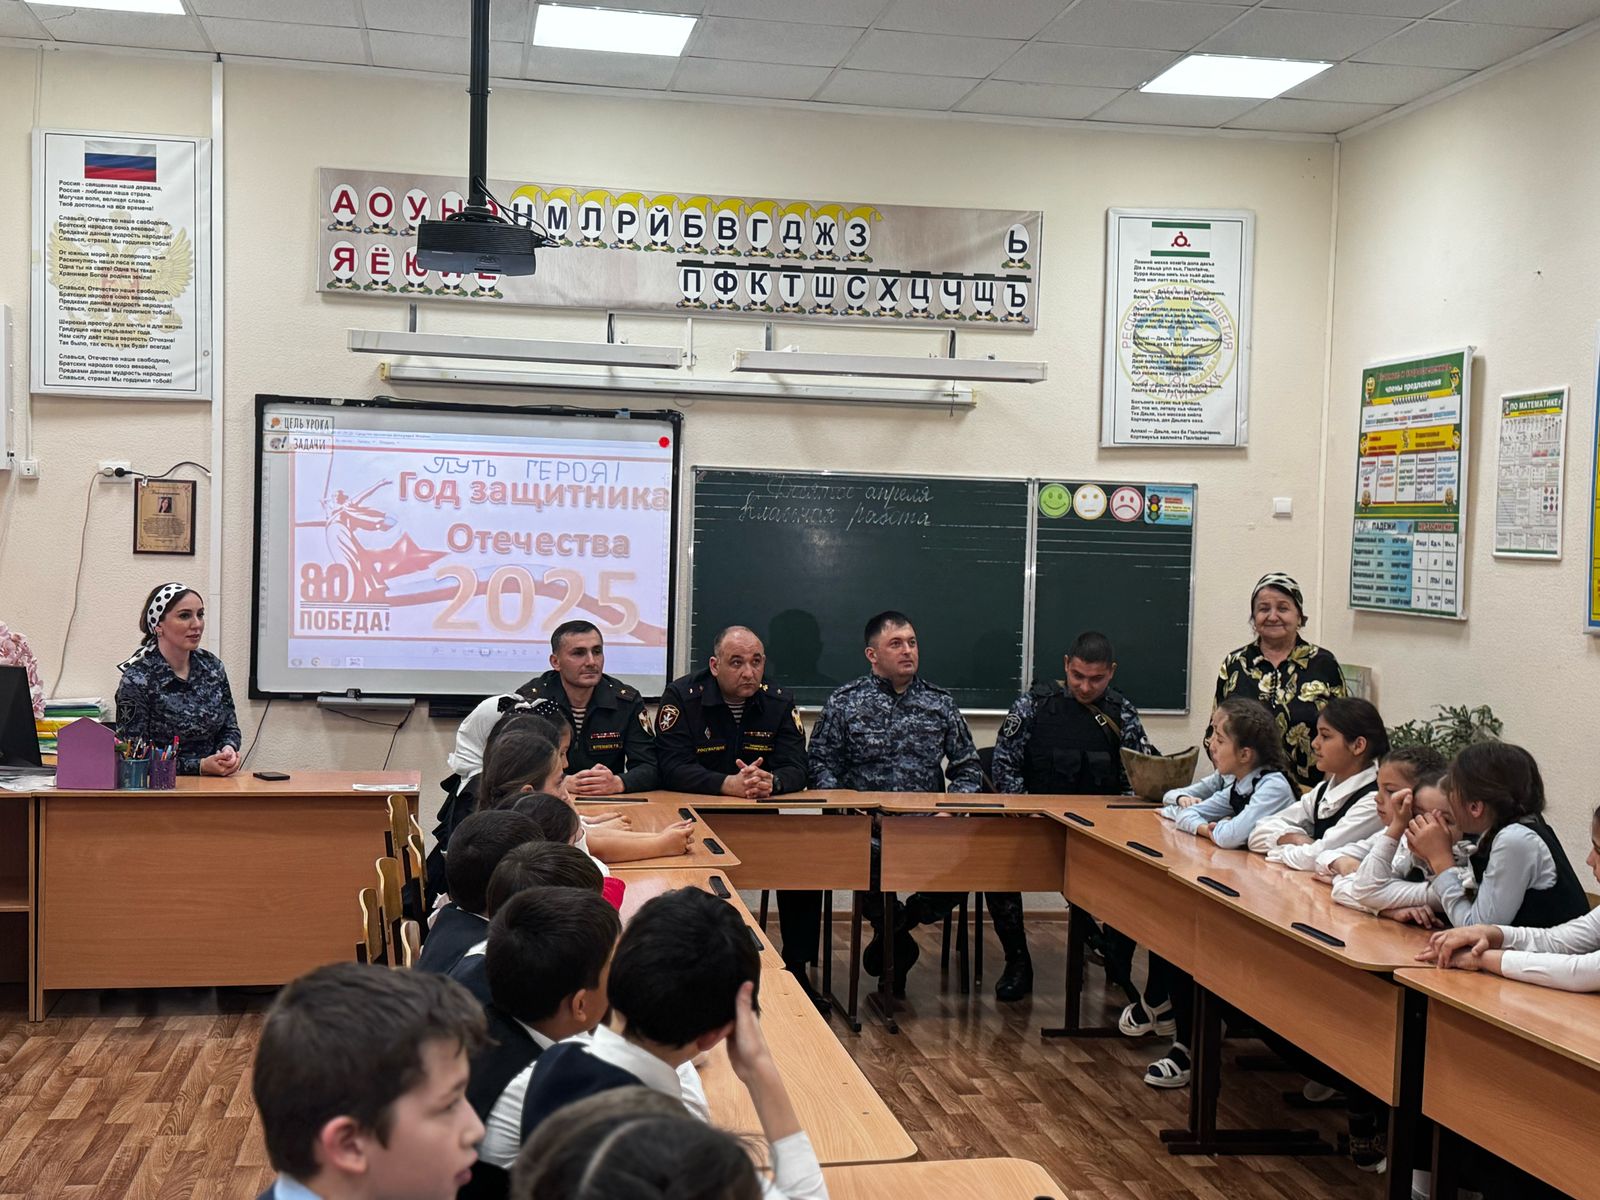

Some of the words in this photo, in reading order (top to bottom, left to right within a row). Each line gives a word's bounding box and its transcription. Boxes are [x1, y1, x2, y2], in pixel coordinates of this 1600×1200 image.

[58, 193, 83, 201] Могучая
[333, 190, 357, 214] А
[369, 192, 393, 217] О
[407, 196, 427, 220] У
[513, 203, 532, 231] Н
[548, 204, 568, 230] М
[581, 204, 601, 231] Л
[618, 209, 636, 234] Р
[650, 207, 668, 237] Й
[684, 215, 703, 239] Б
[719, 216, 736, 240] В
[752, 218, 768, 242] Г
[783, 220, 802, 244] Д
[816, 222, 835, 246] Ж
[849, 223, 867, 247] З
[1008, 230, 1027, 253] Ь
[333, 247, 355, 272] Я
[371, 248, 390, 275] Ё
[684, 269, 701, 292] П
[714, 270, 738, 295] Ф
[751, 272, 768, 295] К
[783, 274, 801, 297] Т
[816, 276, 835, 297] Ш
[847, 276, 866, 299] С
[878, 278, 899, 301] Х
[912, 278, 929, 304] Ц
[944, 280, 962, 305] Ч
[975, 281, 994, 306] Щ
[1007, 284, 1026, 308] Ъ
[58, 360, 86, 368] Братских
[58, 367, 88, 375] Предками
[284, 417, 304, 431] ЦЕЛЬ
[306, 419, 329, 431] УРОКА
[293, 437, 326, 450] ЗАДАЧИ
[423, 456, 496, 477] ПУТЬ
[526, 460, 620, 483] ГЕРОЯ!
[399, 472, 460, 508] Год
[470, 480, 669, 511] защитника
[865, 485, 934, 509] апреля
[846, 501, 931, 531] работа
[447, 522, 631, 557] Отечества
[432, 565, 640, 635] 2025
[300, 610, 390, 634] ПОБЕДА!
